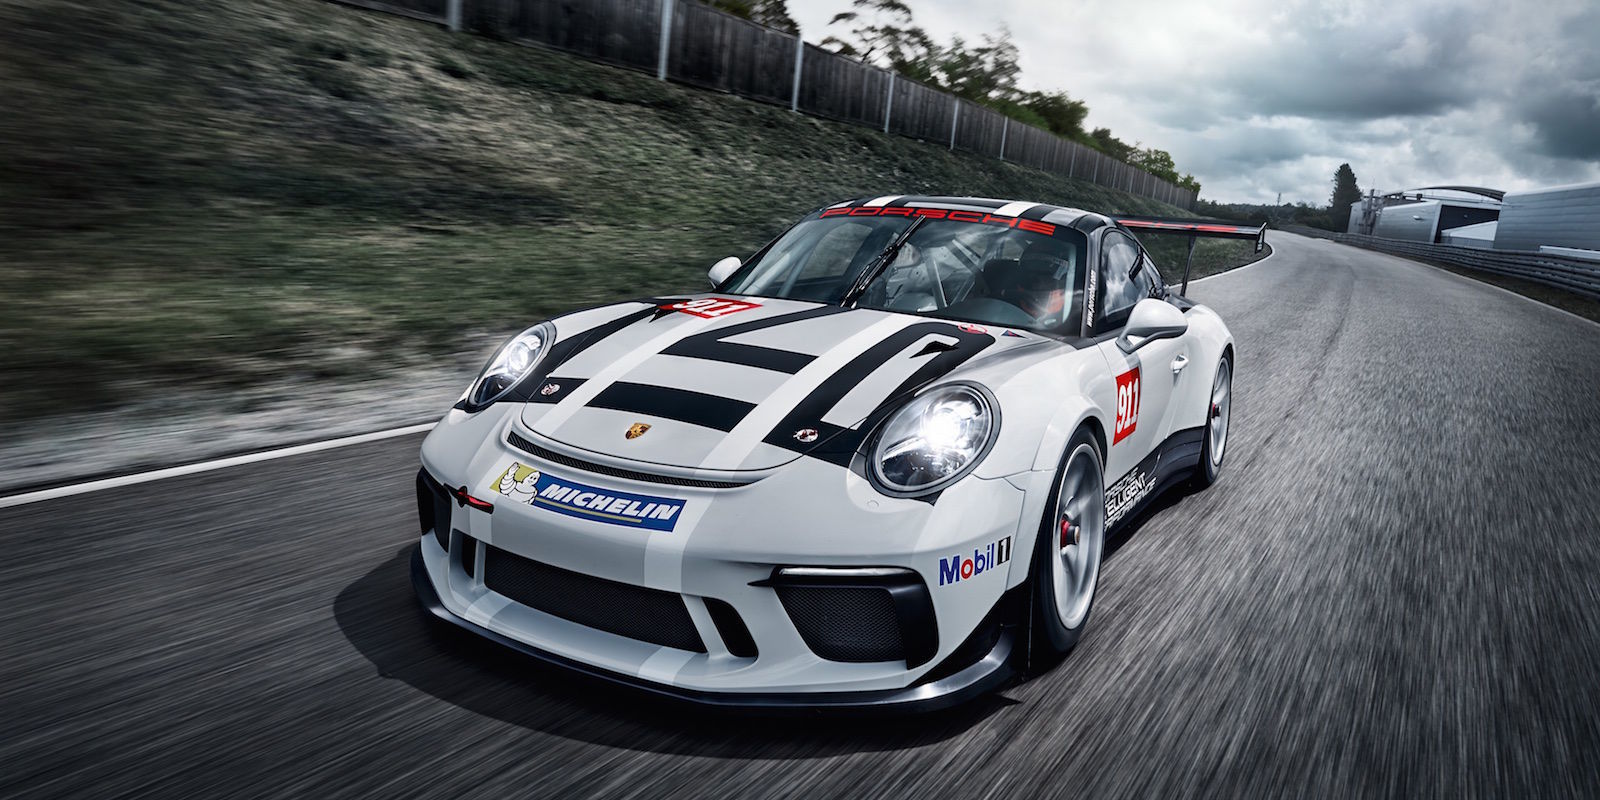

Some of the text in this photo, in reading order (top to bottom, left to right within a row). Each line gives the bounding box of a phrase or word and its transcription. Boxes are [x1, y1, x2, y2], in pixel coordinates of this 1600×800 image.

[819, 207, 1056, 236] PORSCHE
[672, 299, 750, 317] 911
[1086, 269, 1097, 328] www.porsche.com
[1116, 378, 1139, 434] 911
[539, 483, 681, 520] MICHELIN
[939, 537, 1009, 587] Mobil 1
